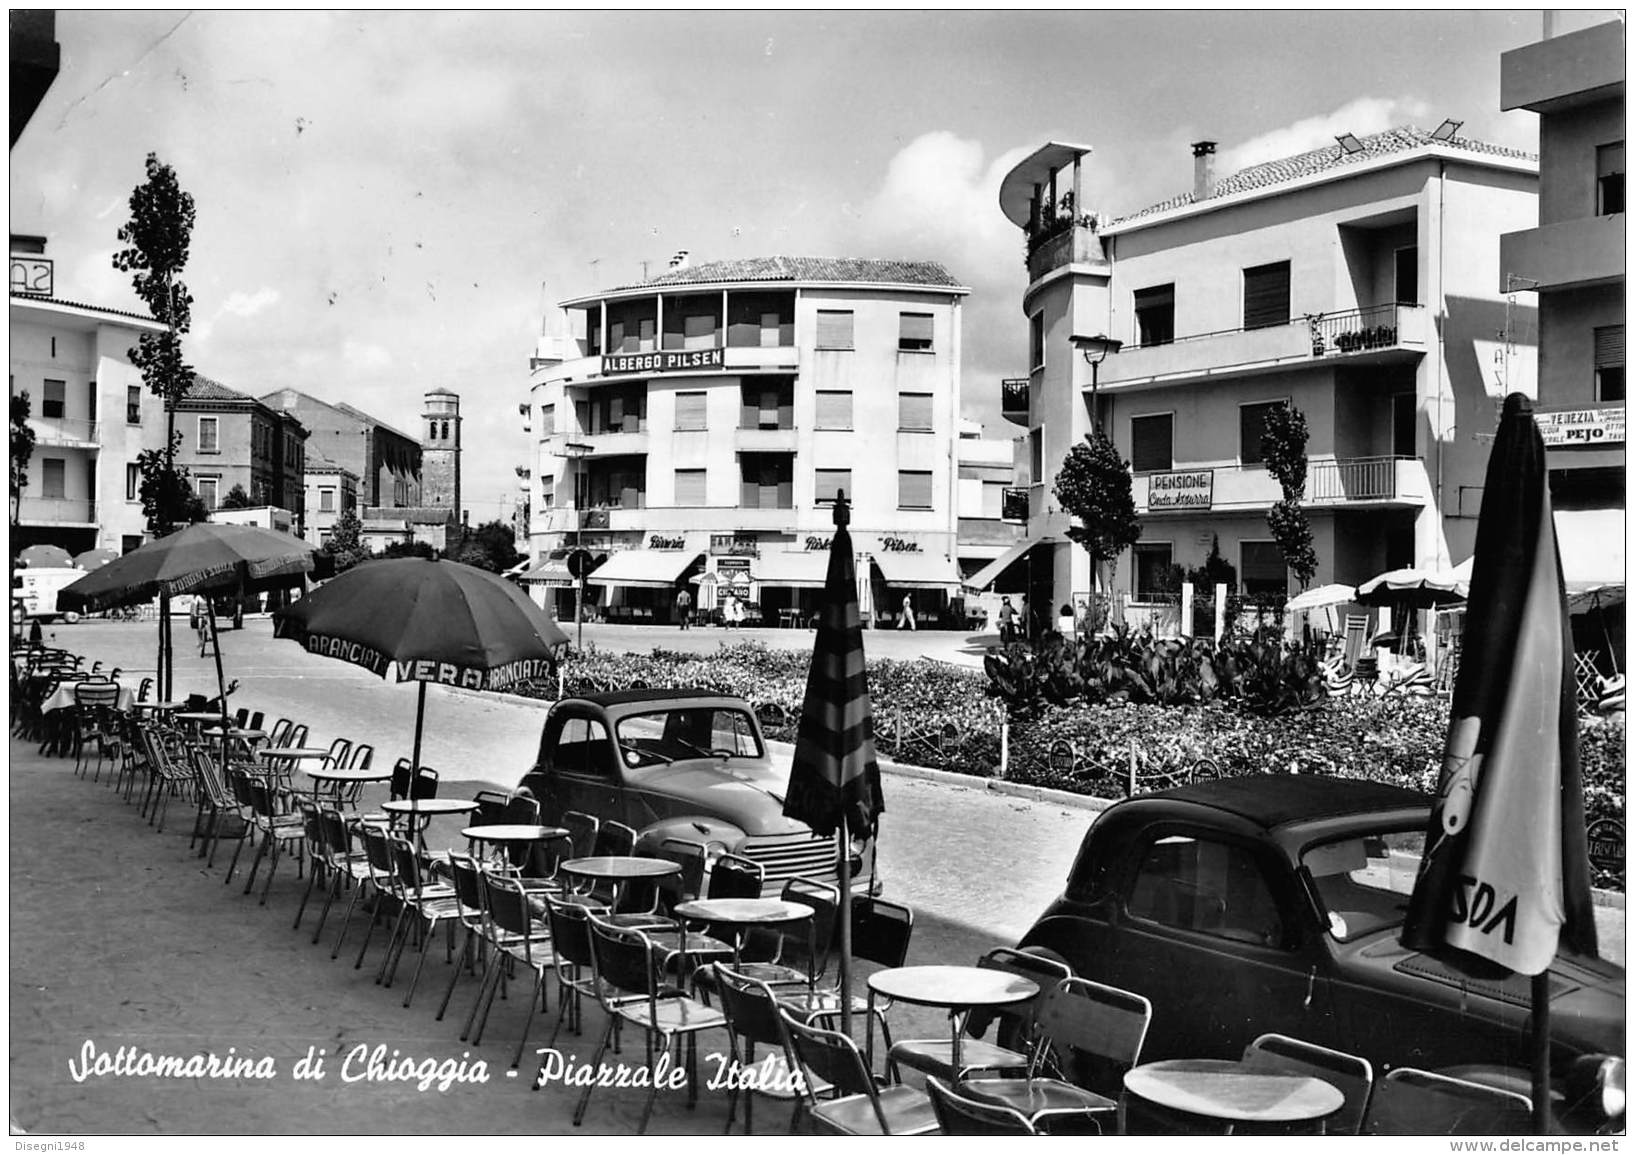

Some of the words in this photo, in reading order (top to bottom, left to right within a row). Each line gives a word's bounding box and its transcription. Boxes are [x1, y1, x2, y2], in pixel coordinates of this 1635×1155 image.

[604, 354, 662, 371] ALBERGO
[667, 350, 721, 368] PILSEN
[1551, 411, 1595, 425] VENEZIA
[1566, 428, 1604, 442] PEJO
[1155, 474, 1207, 490] PENSIONE
[398, 659, 483, 690] VERA
